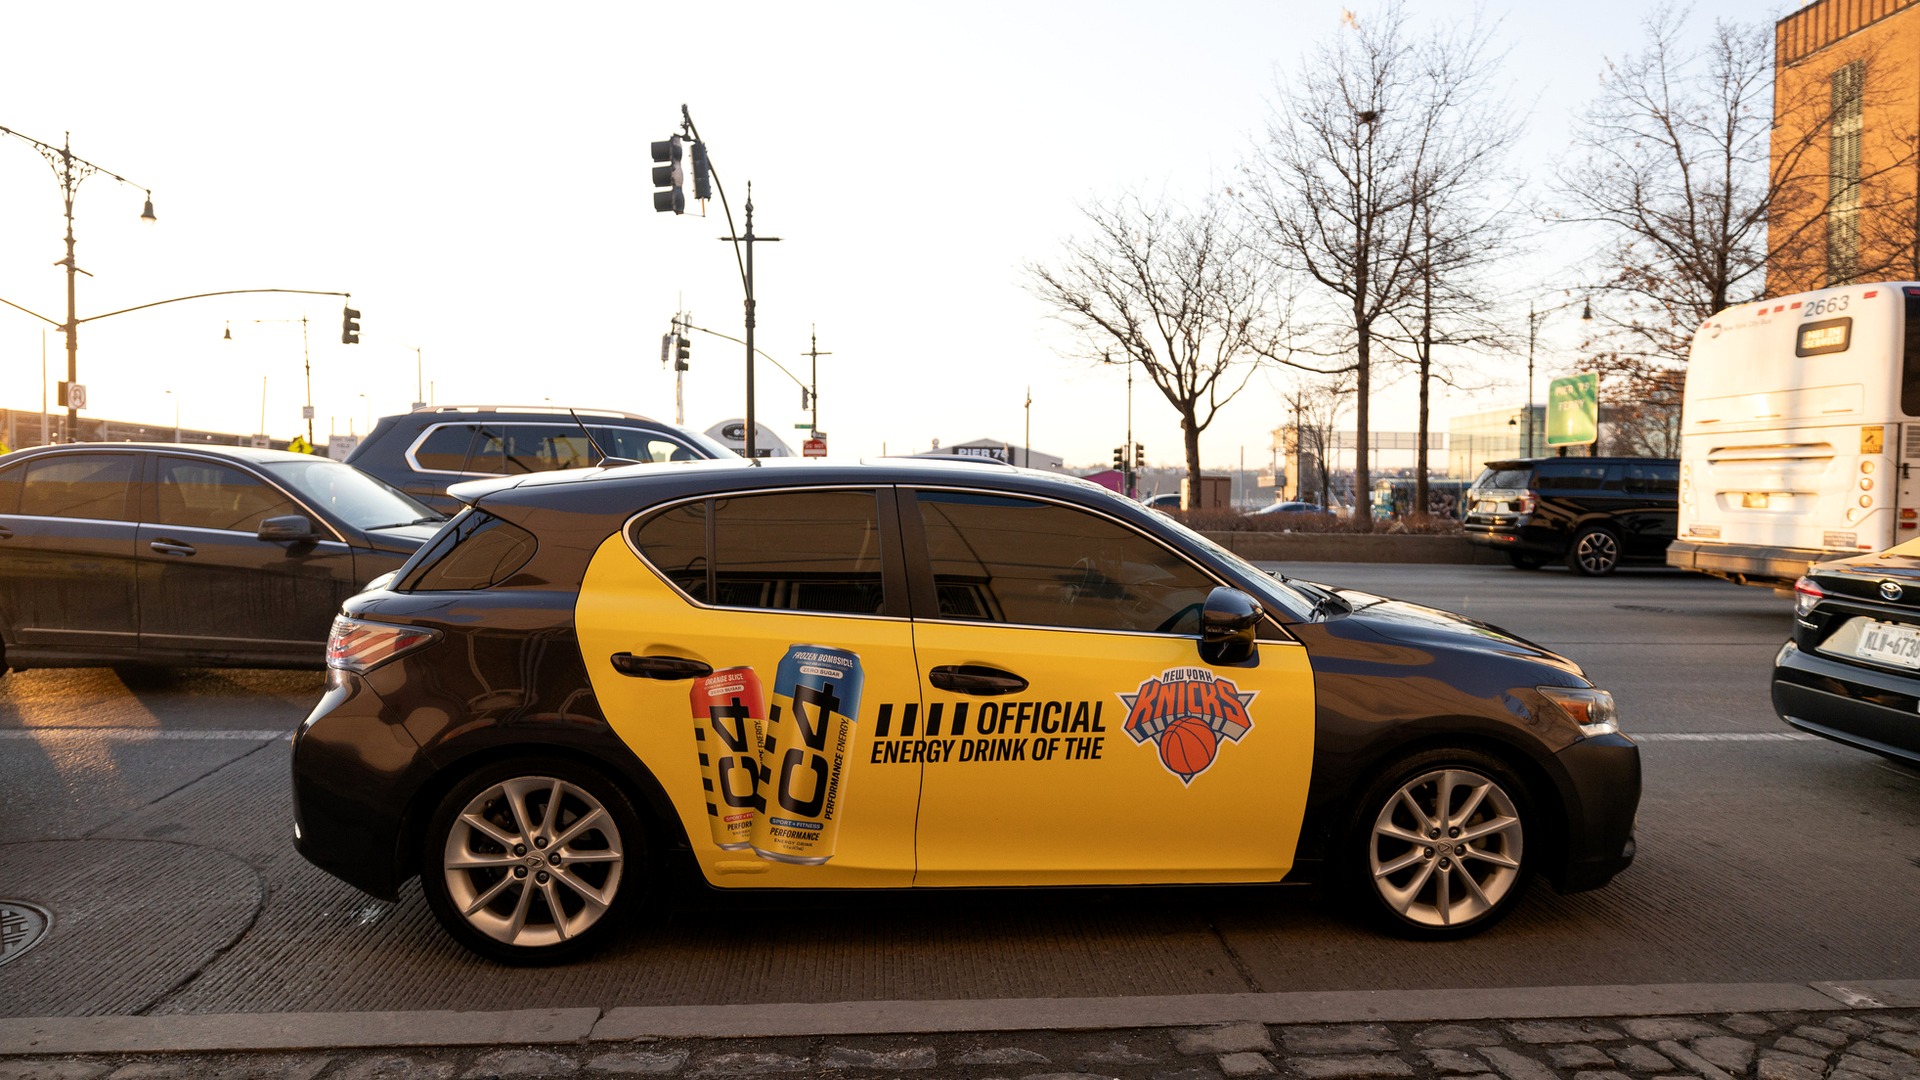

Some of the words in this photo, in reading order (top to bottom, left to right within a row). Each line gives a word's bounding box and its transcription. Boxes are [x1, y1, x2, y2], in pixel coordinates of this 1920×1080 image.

[1804, 295, 1849, 317] 2663
[958, 448, 990, 458] PIER
[792, 651, 817, 661] FROZEN
[818, 653, 853, 668] BOMBSICLE
[705, 675, 727, 686] ORANGE
[728, 673, 744, 682] SLICE
[820, 669, 840, 677] SUGAR
[1162, 669, 1184, 682] NEW
[1186, 668, 1213, 682] YORK
[1128, 678, 1252, 731] KNICKS
[977, 701, 1105, 735] OFFICIAL
[778, 682, 840, 818] C4
[870, 739, 956, 764] ENERGY
[959, 738, 1028, 762] DRINK
[1031, 737, 1061, 761] OF
[1065, 737, 1105, 760] THE
[824, 753, 844, 820] PERFORMANCE
[772, 818, 791, 826] SPORT
[770, 827, 820, 841] PERFORMANCE
